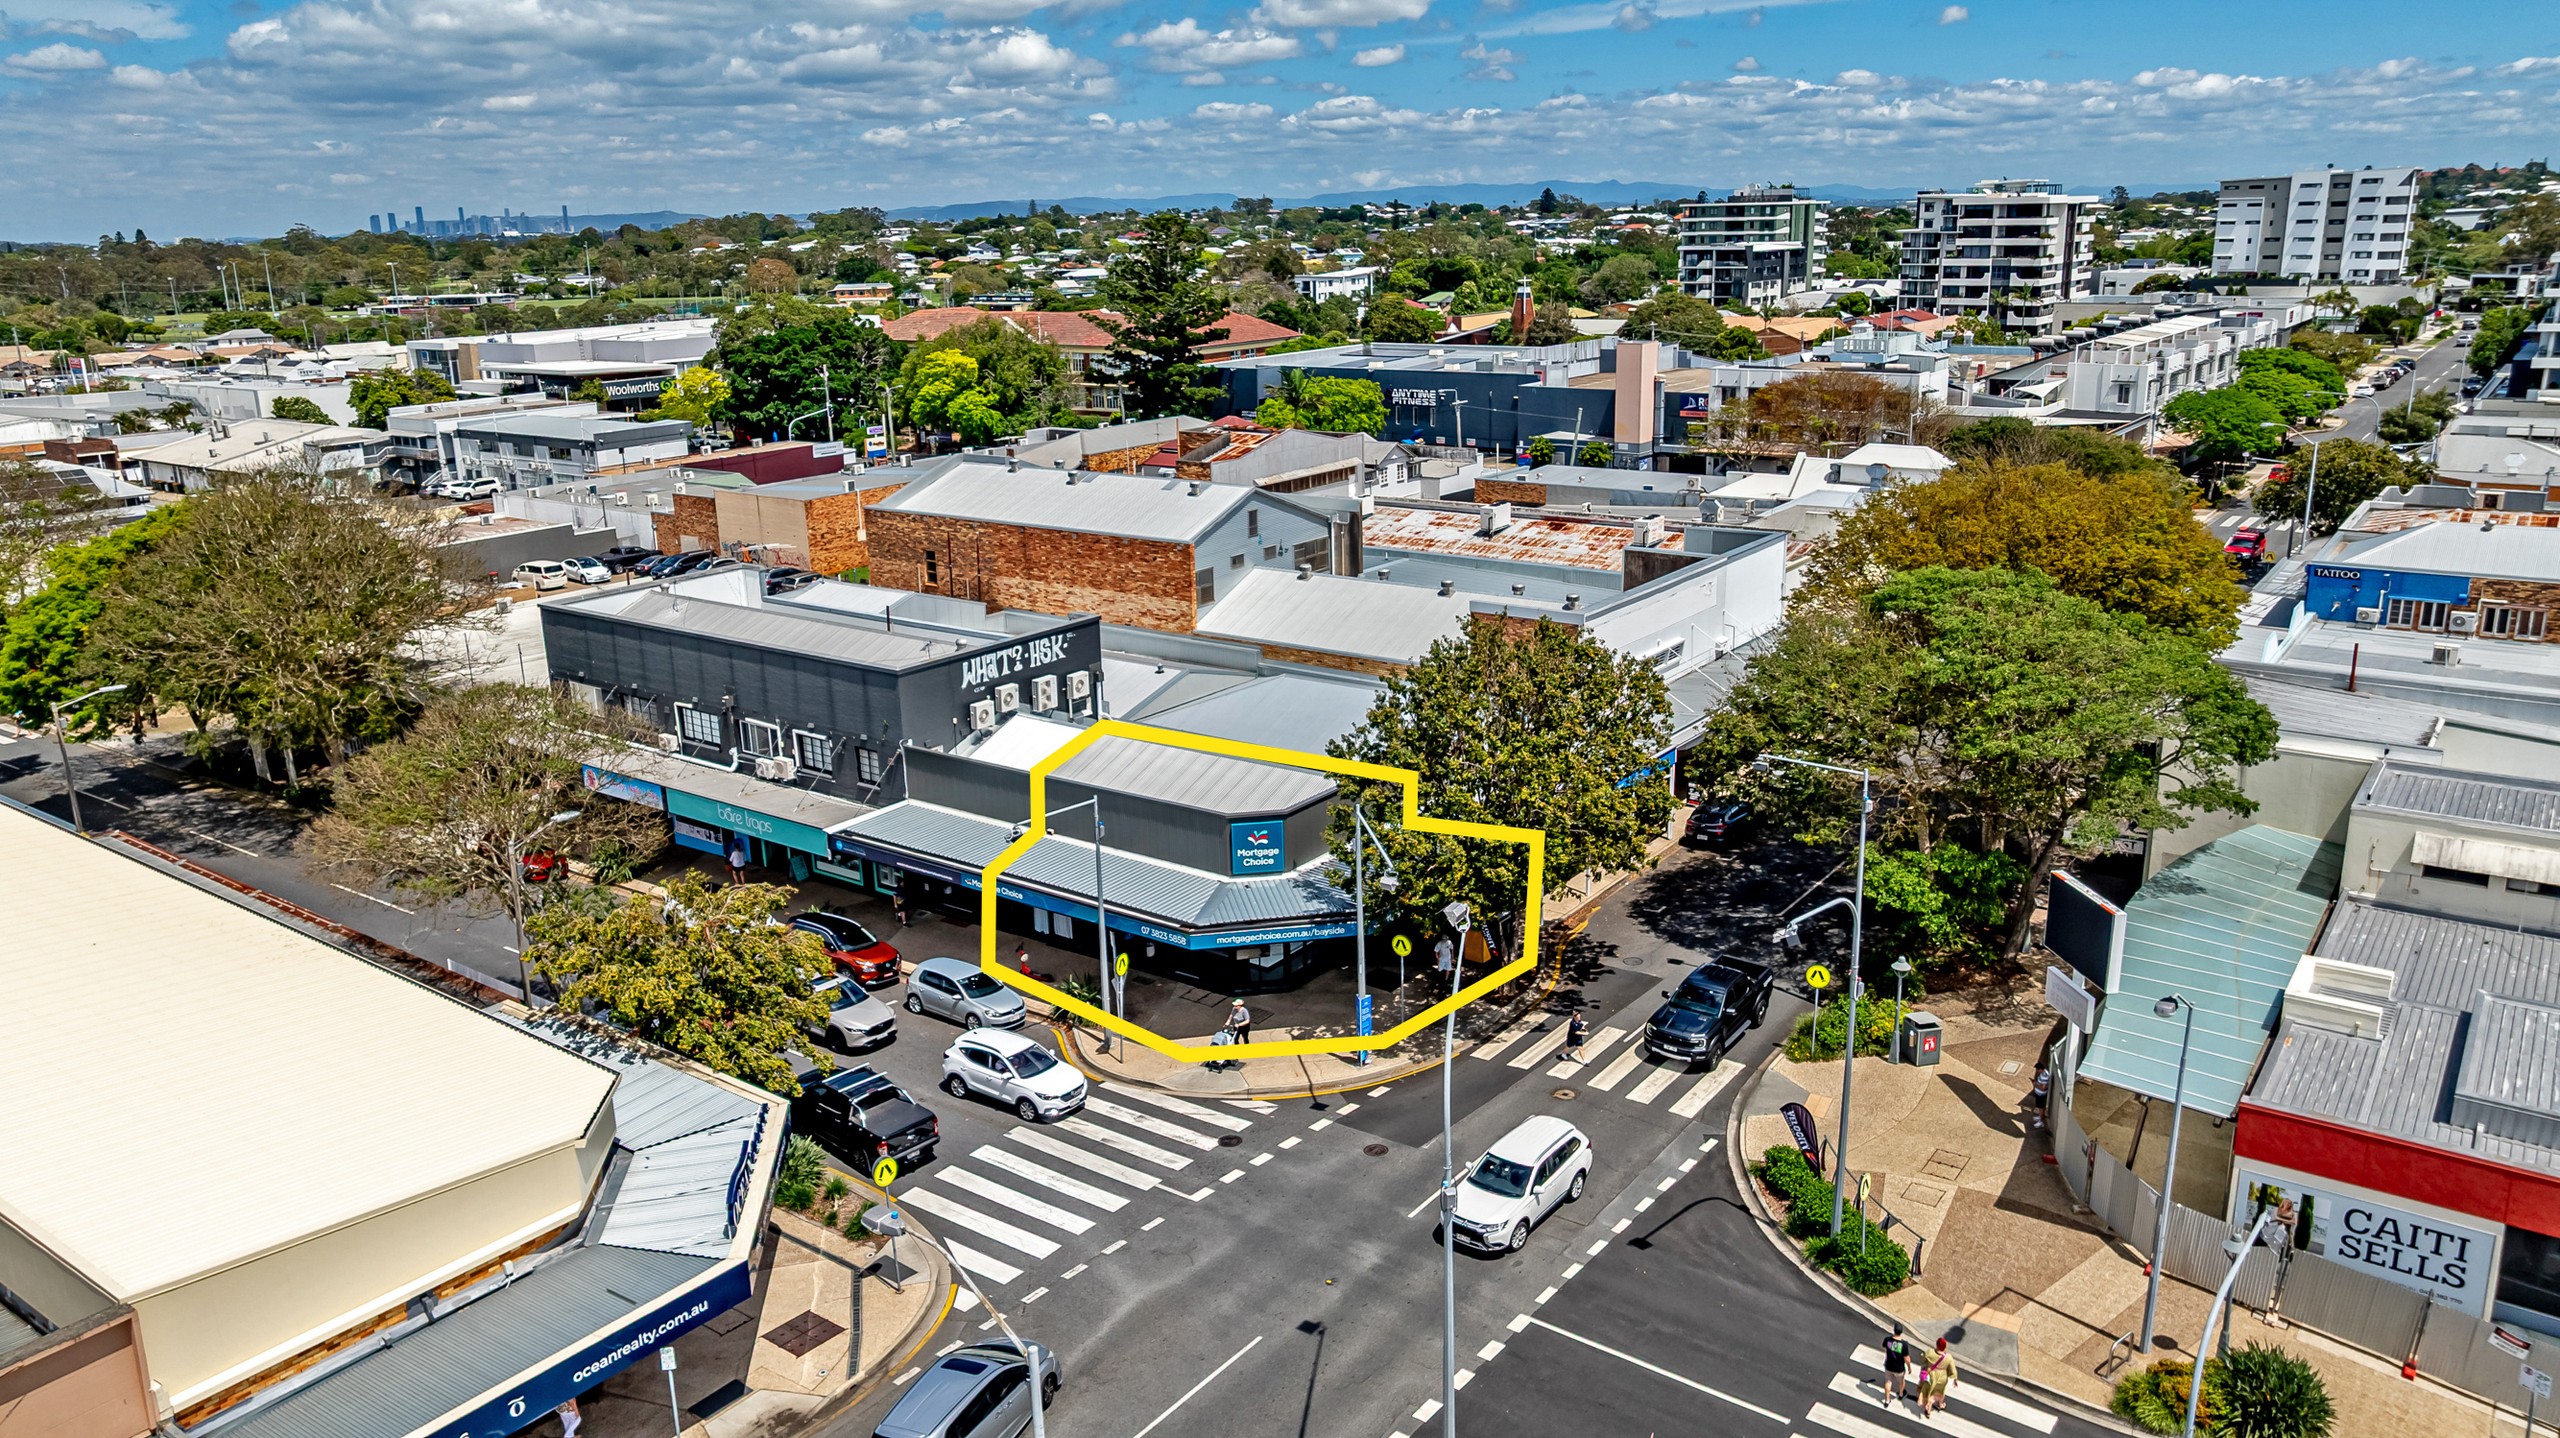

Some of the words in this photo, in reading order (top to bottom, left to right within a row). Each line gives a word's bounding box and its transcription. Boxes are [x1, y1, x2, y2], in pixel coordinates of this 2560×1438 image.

[606, 381, 660, 396] Woolworths
[1392, 388, 1436, 399] ANYTIME
[1392, 397, 1436, 406] FITNESS
[2315, 568, 2360, 579] TATTOO
[744, 810, 772, 834] traps
[1237, 848, 1279, 857] Mortgage
[1243, 857, 1274, 867] Choice
[1001, 887, 1023, 900] Choice
[1140, 926, 1151, 935] 07
[1150, 928, 1169, 942] 3823
[1169, 931, 1187, 946] 5858
[1216, 926, 1345, 945] mortgagechoice.com.au/bayside
[1786, 1110, 1810, 1151] VELOCITY
[2343, 1208, 2471, 1263] CAITI
[2338, 1234, 2467, 1289] SELLS
[573, 1300, 708, 1384] oceanrealty.com.au
